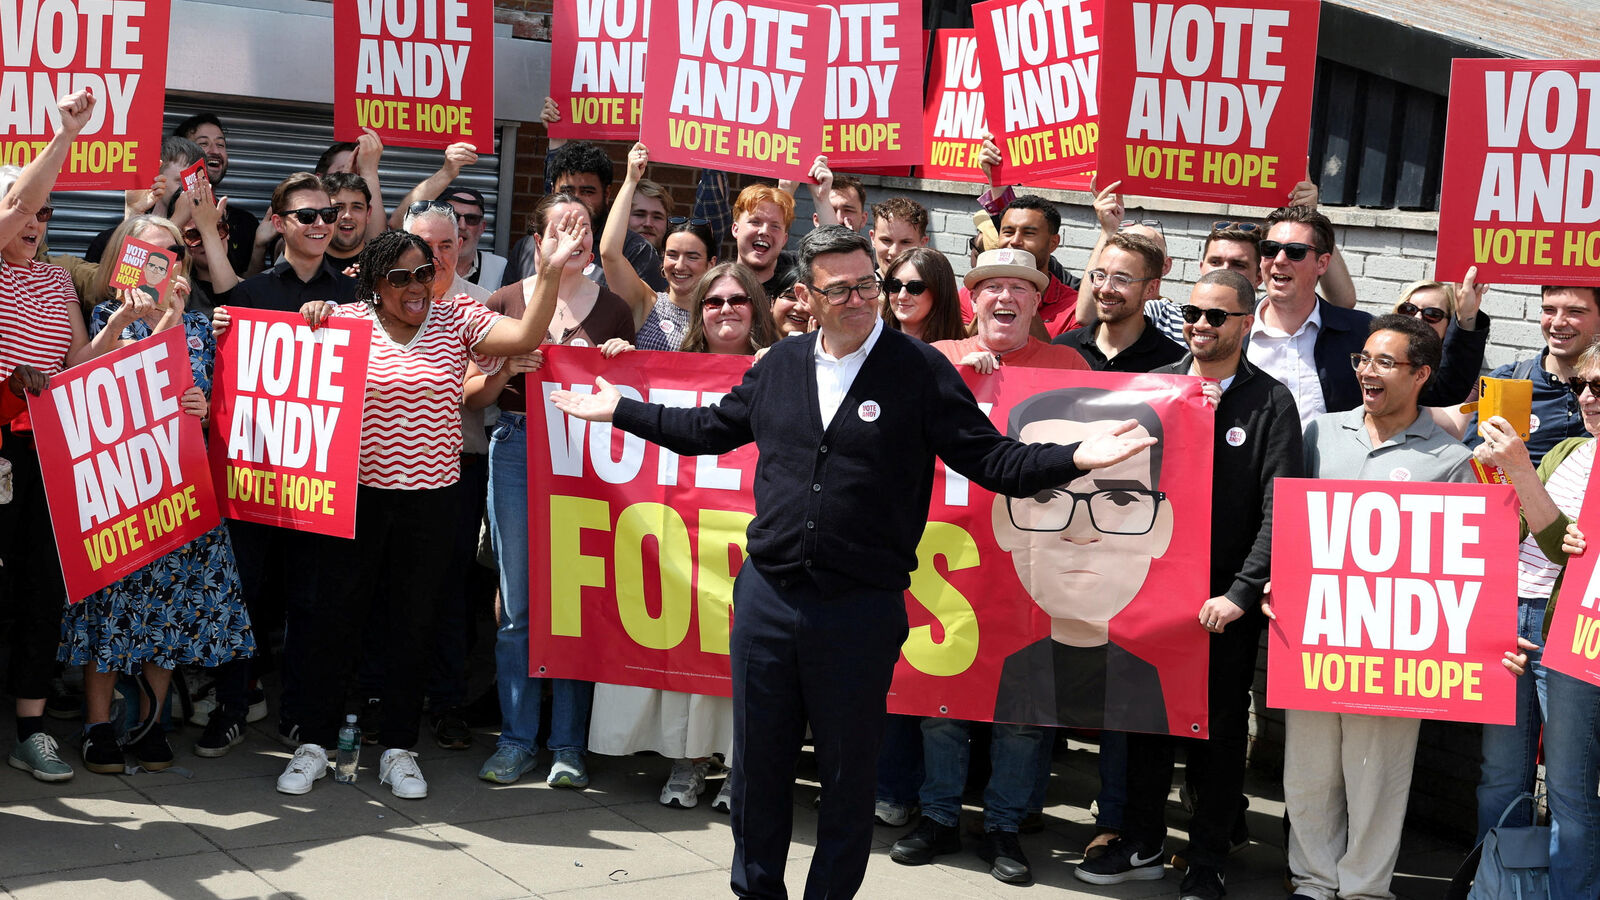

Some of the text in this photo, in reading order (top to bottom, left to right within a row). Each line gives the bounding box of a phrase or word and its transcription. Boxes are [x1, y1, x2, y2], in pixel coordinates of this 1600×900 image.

[0, 0, 146, 69] VOTE
[357, 0, 472, 42] VOTE
[677, 0, 809, 73] VOTE
[990, 0, 1100, 72] VOTE
[1132, 2, 1290, 82] VOTE
[355, 38, 471, 101] ANDY
[669, 57, 803, 130] ANDY
[1003, 54, 1100, 133] ANDY
[0, 71, 141, 135] ANDY
[355, 98, 473, 136] VOTE HOPE
[570, 97, 625, 125] VOTE
[1126, 76, 1282, 149] ANDY
[70, 141, 139, 174] HOPE
[668, 118, 731, 155] VOTE
[736, 128, 801, 165] HOPE
[840, 123, 901, 152] HOPE
[930, 141, 968, 168] VOTE
[1006, 130, 1057, 167] VOTE
[1125, 144, 1279, 189] VOTE HOPE
[119, 263, 142, 279] VOTE
[122, 253, 146, 268] ANDY
[126, 243, 149, 260] VOTE
[1473, 228, 1555, 266] VOTE
[115, 273, 139, 288] HOPE
[236, 319, 350, 403] VOTE
[51, 342, 179, 460] VOTE
[227, 394, 341, 473] ANDY
[73, 417, 184, 533] ANDY
[226, 465, 336, 516] VOTE HOPE
[83, 517, 144, 572] VOTE
[147, 485, 201, 543] HOPE
[1306, 490, 1486, 577] VOTE
[549, 494, 758, 655] FOR
[1301, 573, 1483, 655] ANDY
[1301, 652, 1484, 702] VOTE HOPE
